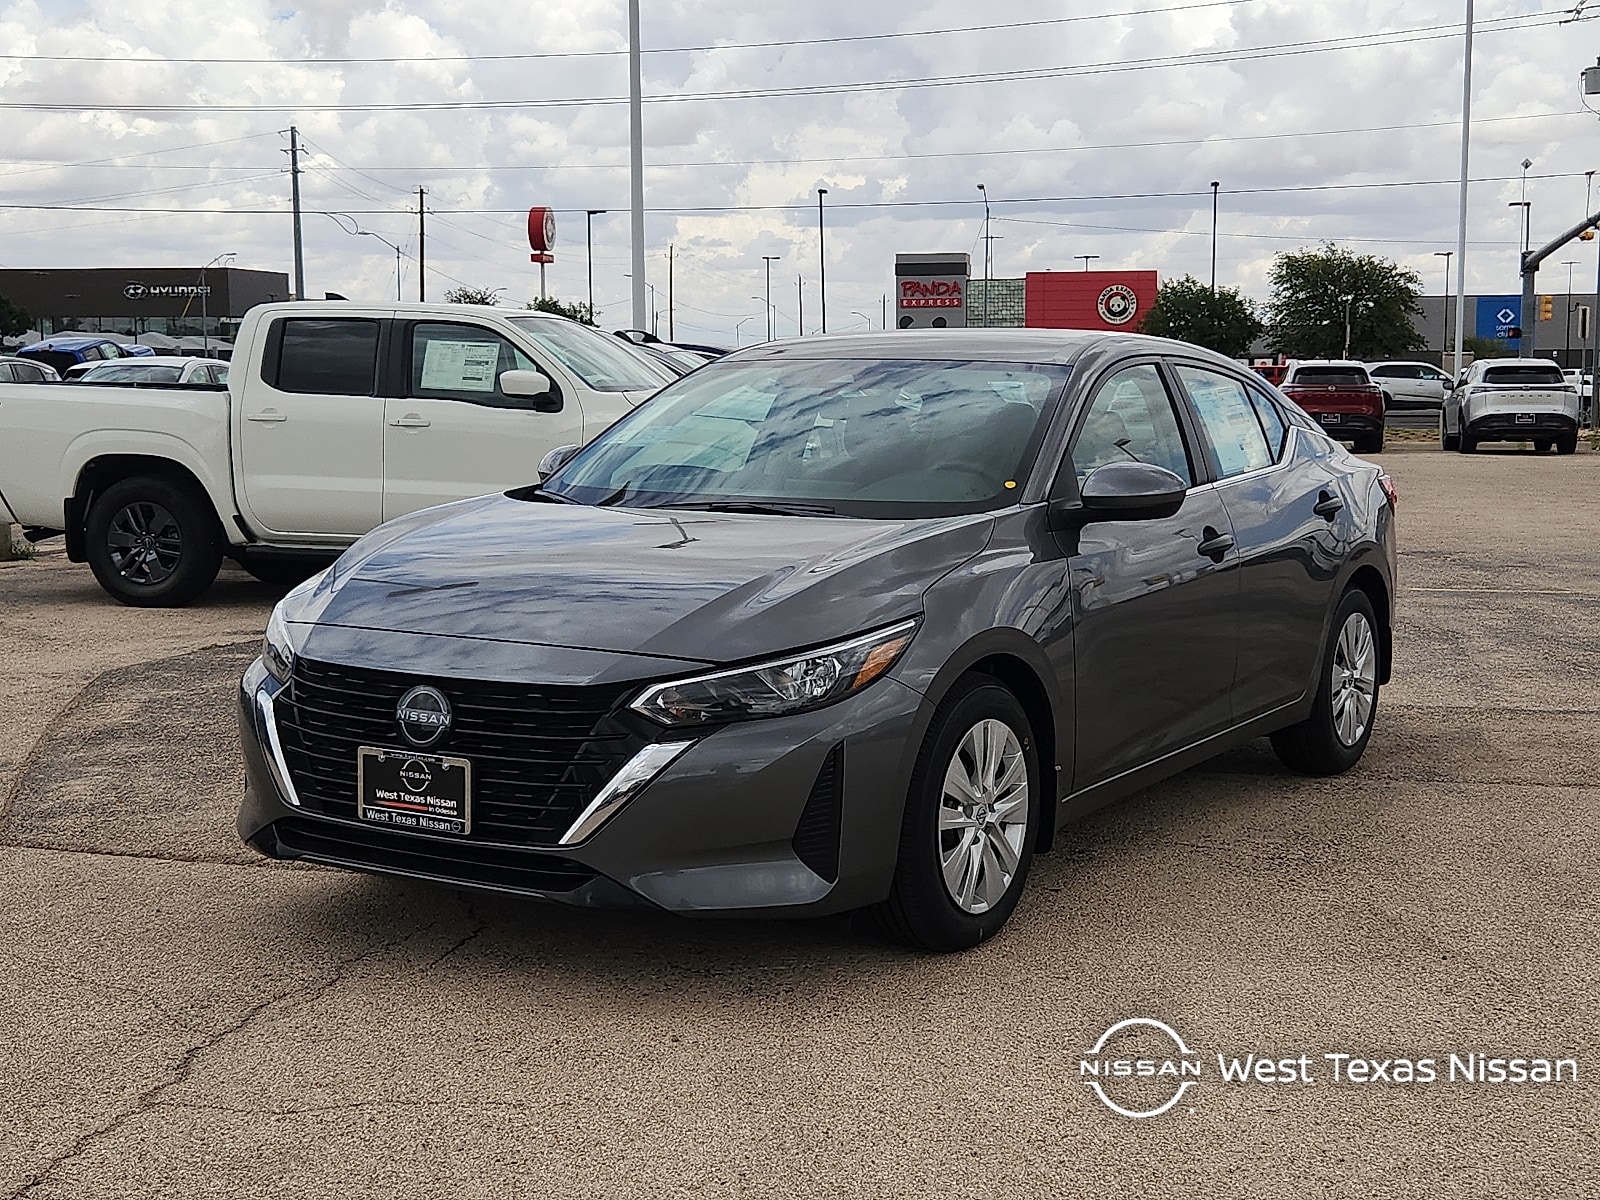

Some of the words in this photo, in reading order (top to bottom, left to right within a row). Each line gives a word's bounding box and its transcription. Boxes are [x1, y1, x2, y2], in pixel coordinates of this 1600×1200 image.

[150, 286, 211, 297] HYUNDAI
[901, 281, 961, 297] PANDA
[1098, 286, 1115, 306] PANDA
[1115, 285, 1136, 306] EXPRESS
[902, 299, 959, 307] EXPRESS
[397, 710, 450, 725] NISSAN
[400, 770, 432, 781] NISSAN
[375, 789, 398, 800] West
[399, 791, 426, 804] Texas
[426, 795, 457, 809] Nissan
[435, 807, 458, 816] Odessa
[366, 808, 390, 821] West
[391, 812, 417, 826] Texas
[419, 816, 451, 831] Nissan
